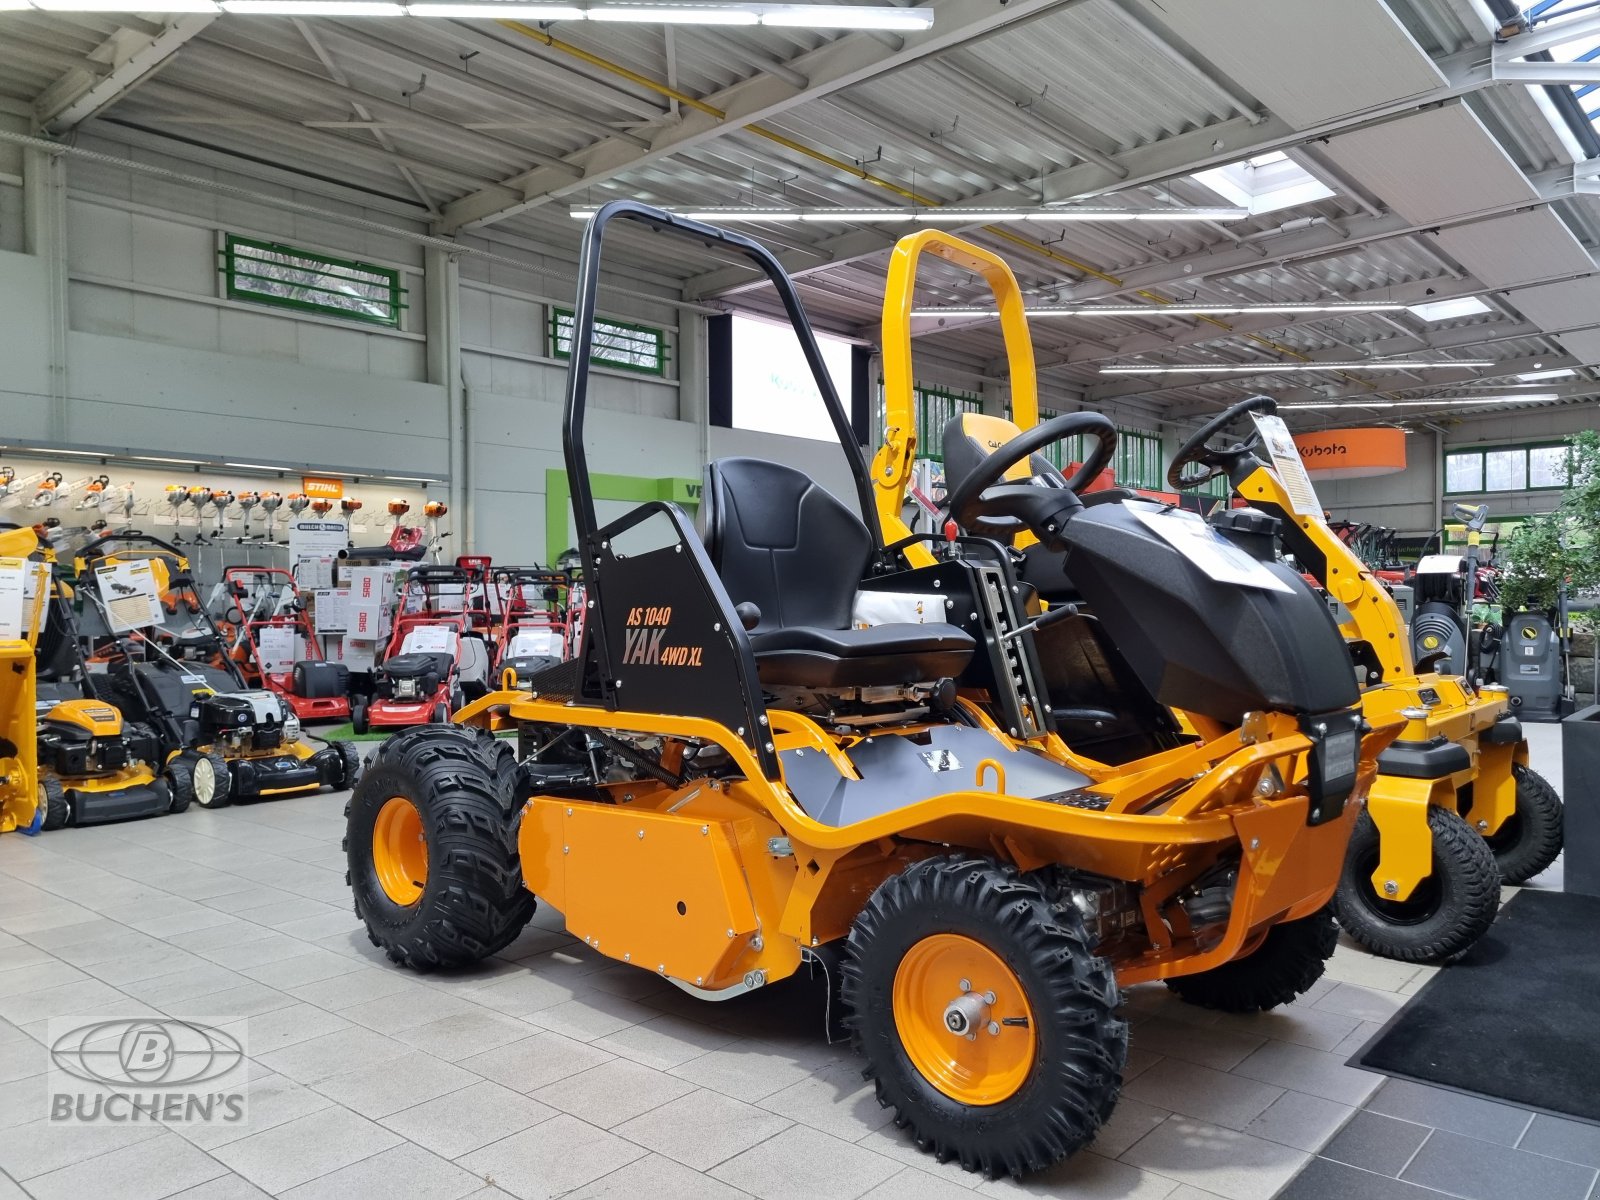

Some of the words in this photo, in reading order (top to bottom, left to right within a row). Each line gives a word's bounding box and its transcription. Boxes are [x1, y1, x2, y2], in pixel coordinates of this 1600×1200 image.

[1297, 443, 1347, 457] Kubota
[307, 483, 338, 492] STIHL
[362, 577, 371, 598] SABO
[358, 612, 367, 632] SABO
[626, 608, 642, 626] AS
[643, 607, 671, 625] 1040
[622, 628, 666, 664] YAK
[660, 647, 687, 665] 4WD
[687, 648, 702, 666] XL
